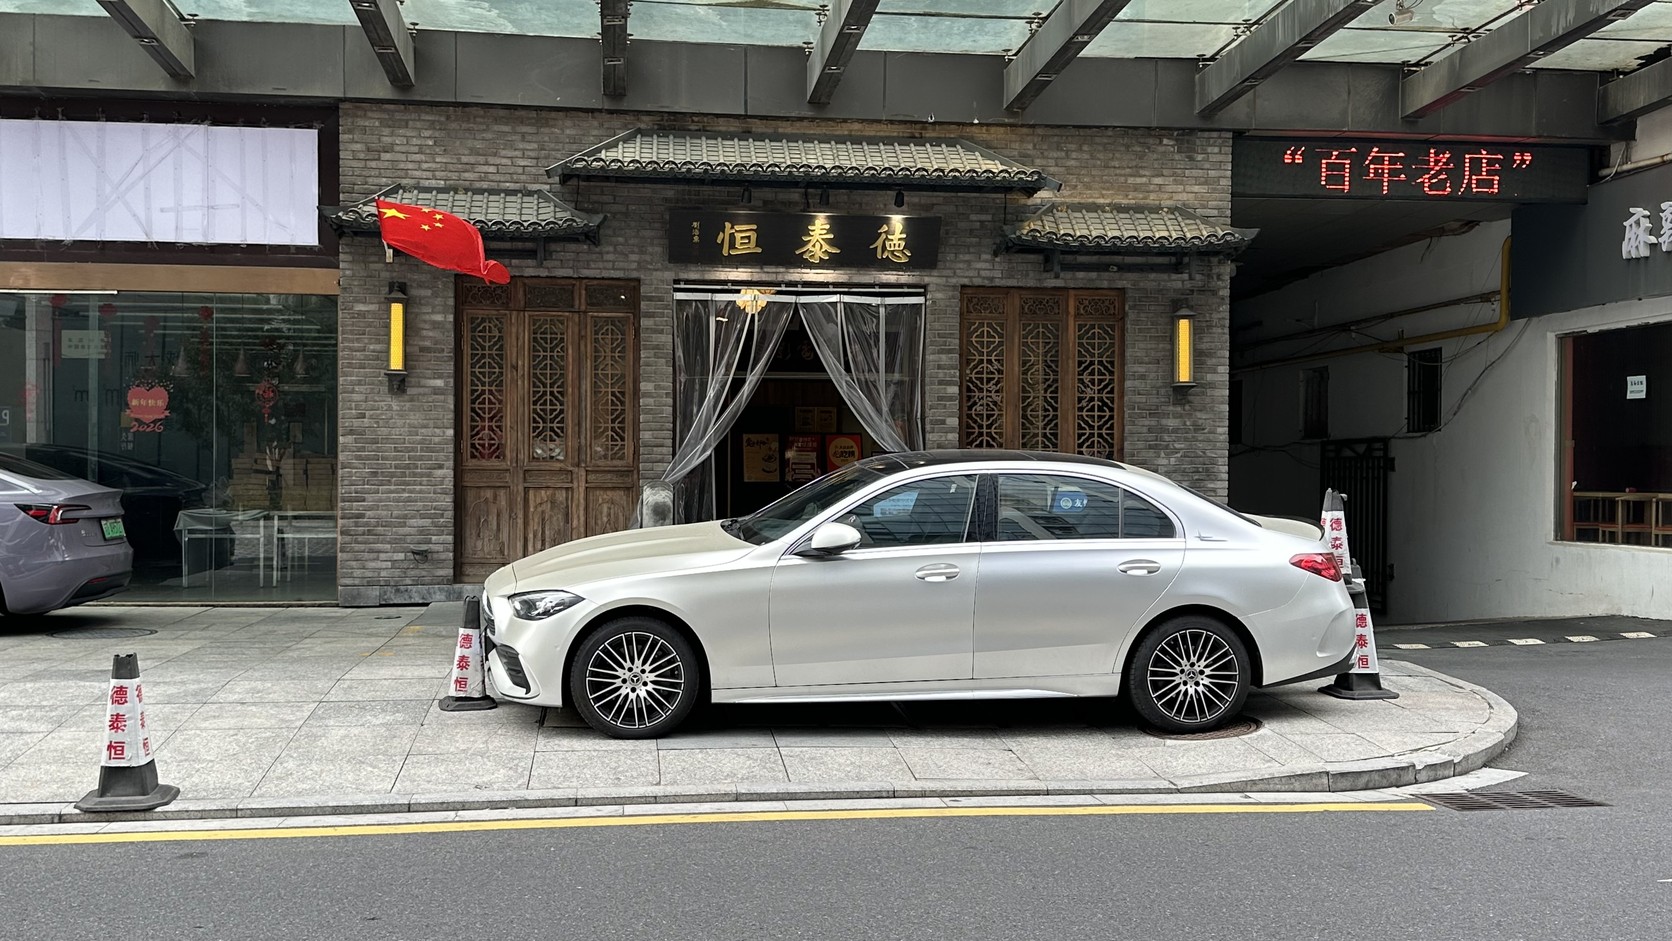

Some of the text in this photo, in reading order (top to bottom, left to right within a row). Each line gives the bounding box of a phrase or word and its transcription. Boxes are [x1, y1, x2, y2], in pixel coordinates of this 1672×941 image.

[130, 420, 164, 433] 2026
[131, 398, 165, 407] 新年快乐
[453, 633, 473, 693] 德泰恒
[1355, 613, 1370, 669] 德泰恒
[106, 685, 129, 761] 德泰恒
